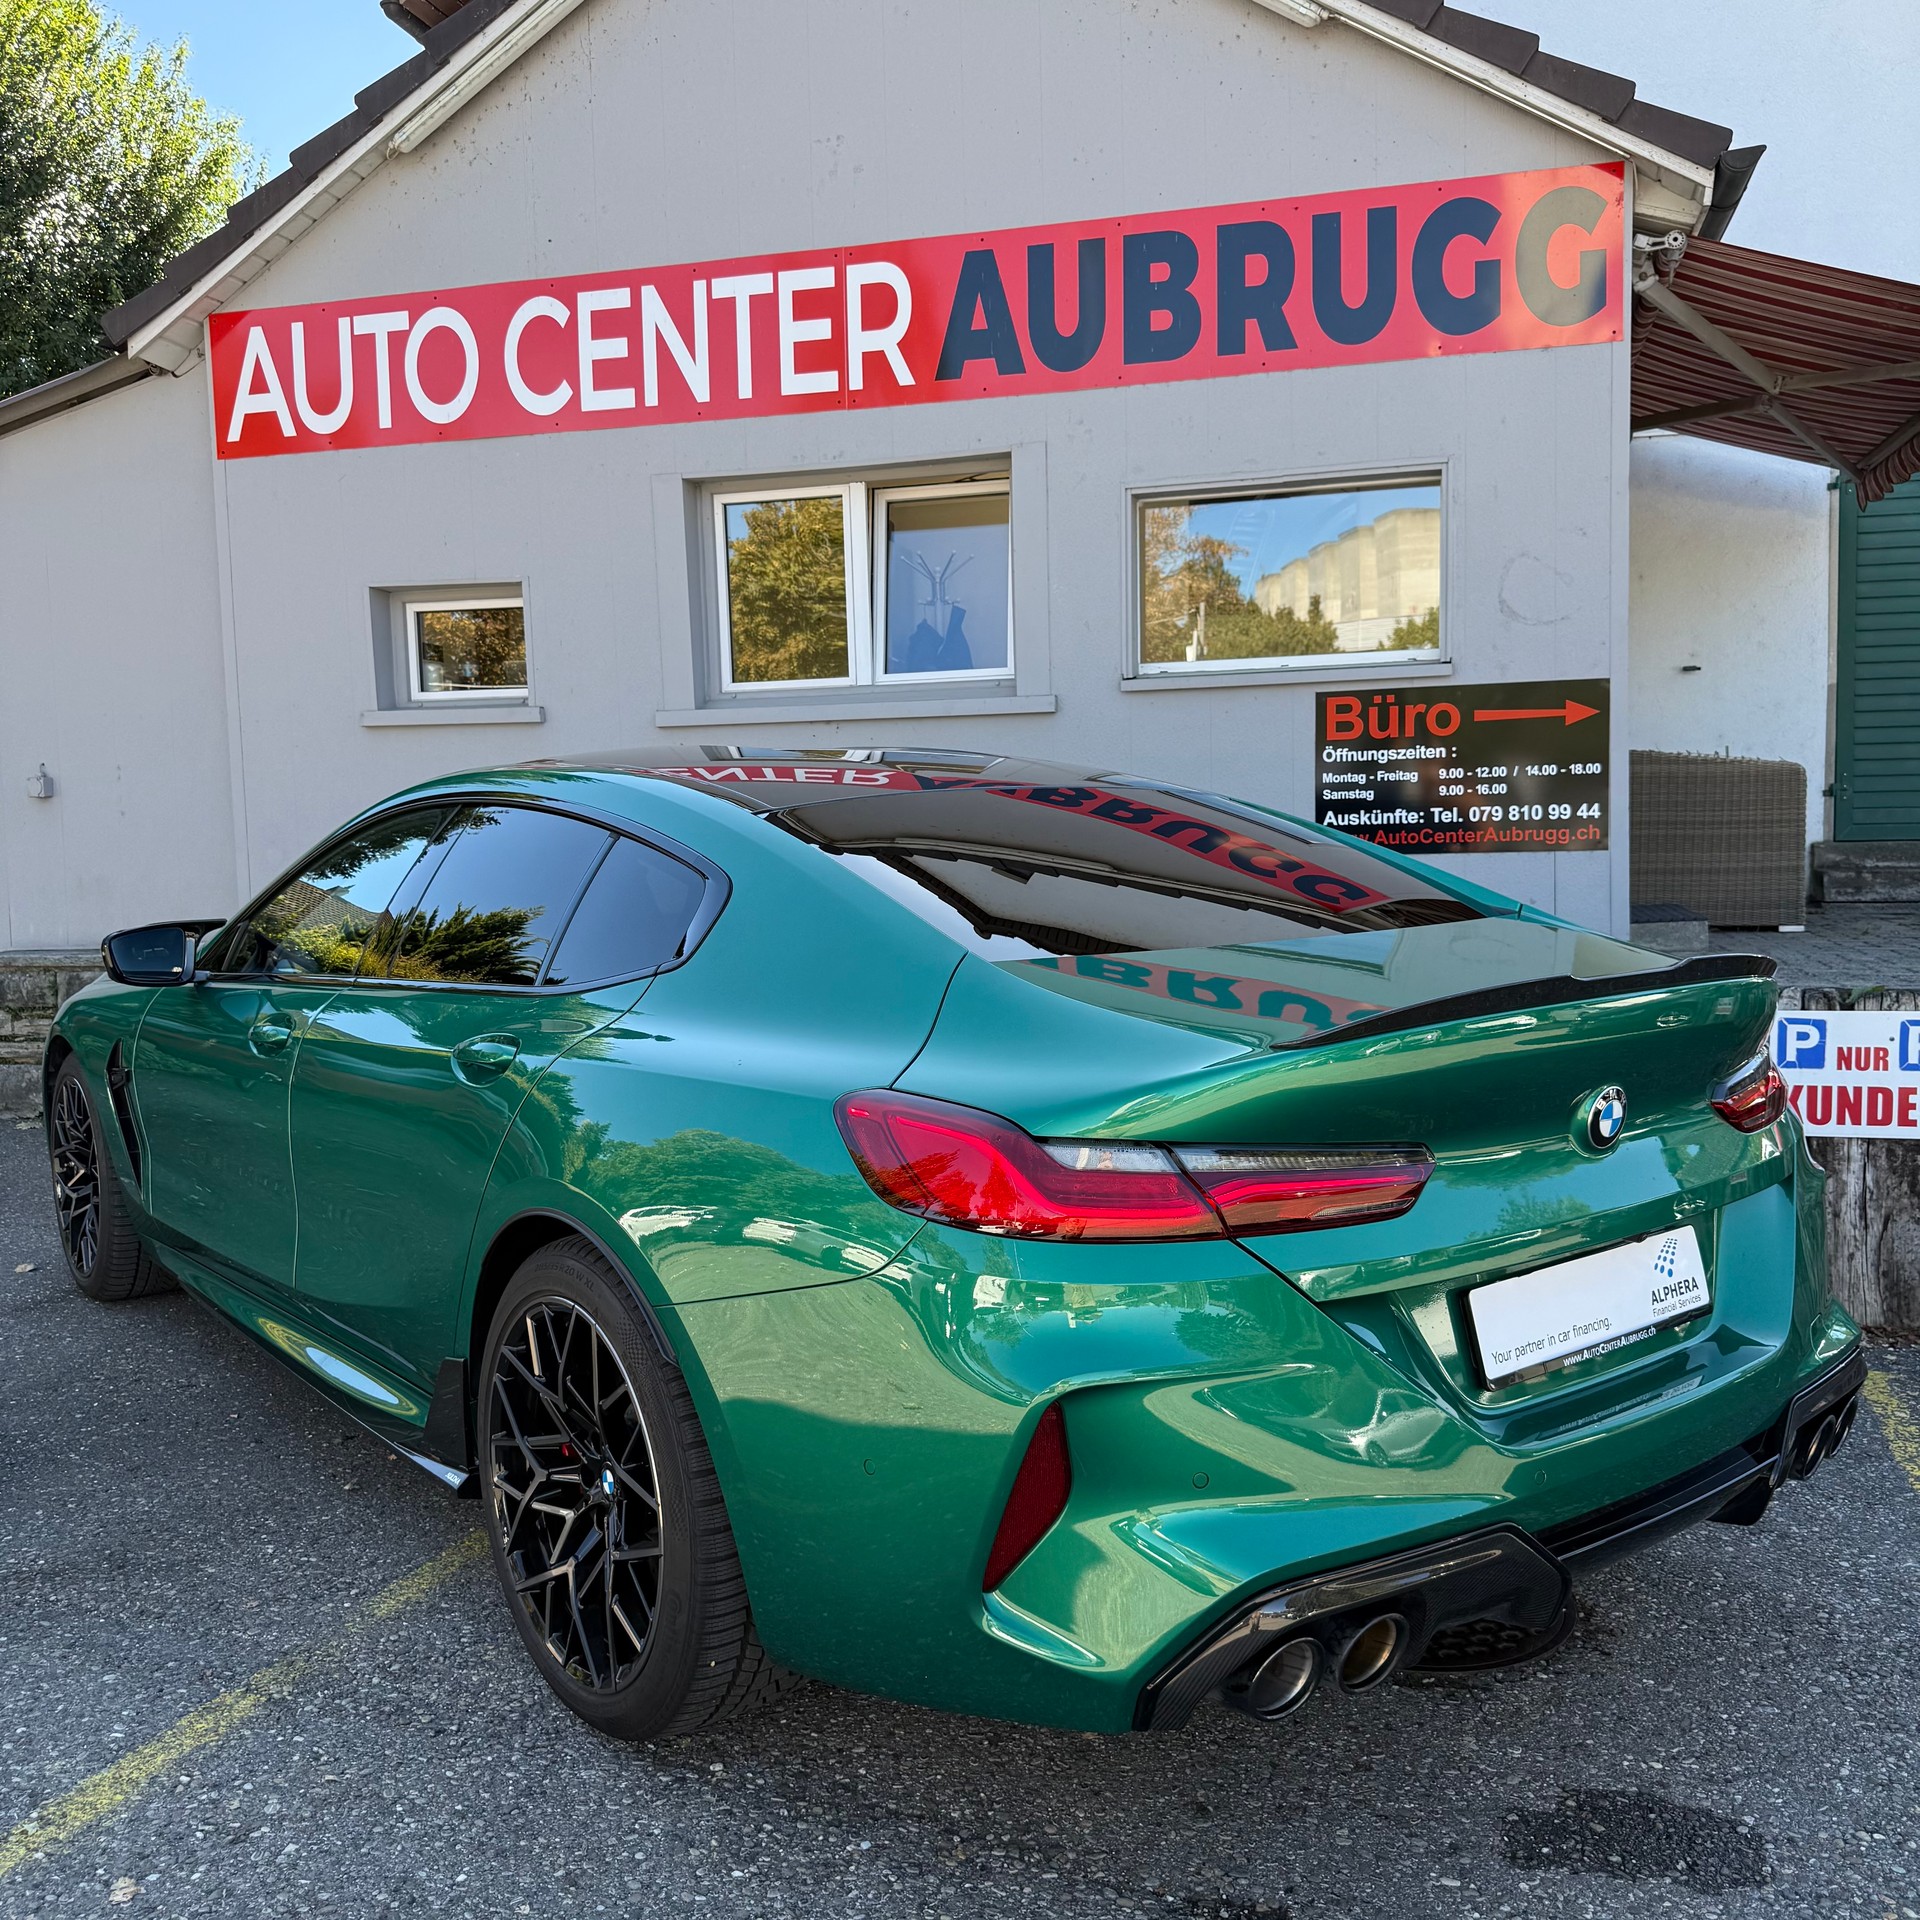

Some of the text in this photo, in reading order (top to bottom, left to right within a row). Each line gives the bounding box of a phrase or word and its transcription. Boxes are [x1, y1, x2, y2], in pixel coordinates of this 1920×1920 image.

[227, 186, 1608, 443] AUTO CENTER AUBRUGG
[1326, 694, 1461, 741] Büro
[1322, 745, 1447, 764] Öffnungszeiten
[1322, 772, 1366, 785] Montag
[1377, 770, 1419, 783] Freitag
[1438, 768, 1464, 780] 9.00
[1475, 766, 1507, 778] 12.00
[1525, 764, 1557, 776] 14.00
[1569, 763, 1602, 775] 18.00
[1322, 788, 1375, 801] Samstag
[1438, 785, 1464, 796] 9.00
[1475, 783, 1507, 795] 16.00
[1323, 803, 1601, 826] Auskünfte: Tel. 079 810 99 44
[1353, 824, 1601, 844] wAutoCenterAubrugg.ch
[1837, 1047, 1889, 1071] NUR
[1651, 1277, 1699, 1305] ALPHERA
[1653, 1294, 1702, 1317] Financial Services
[1491, 1317, 1612, 1365] Your partner in car financing.
